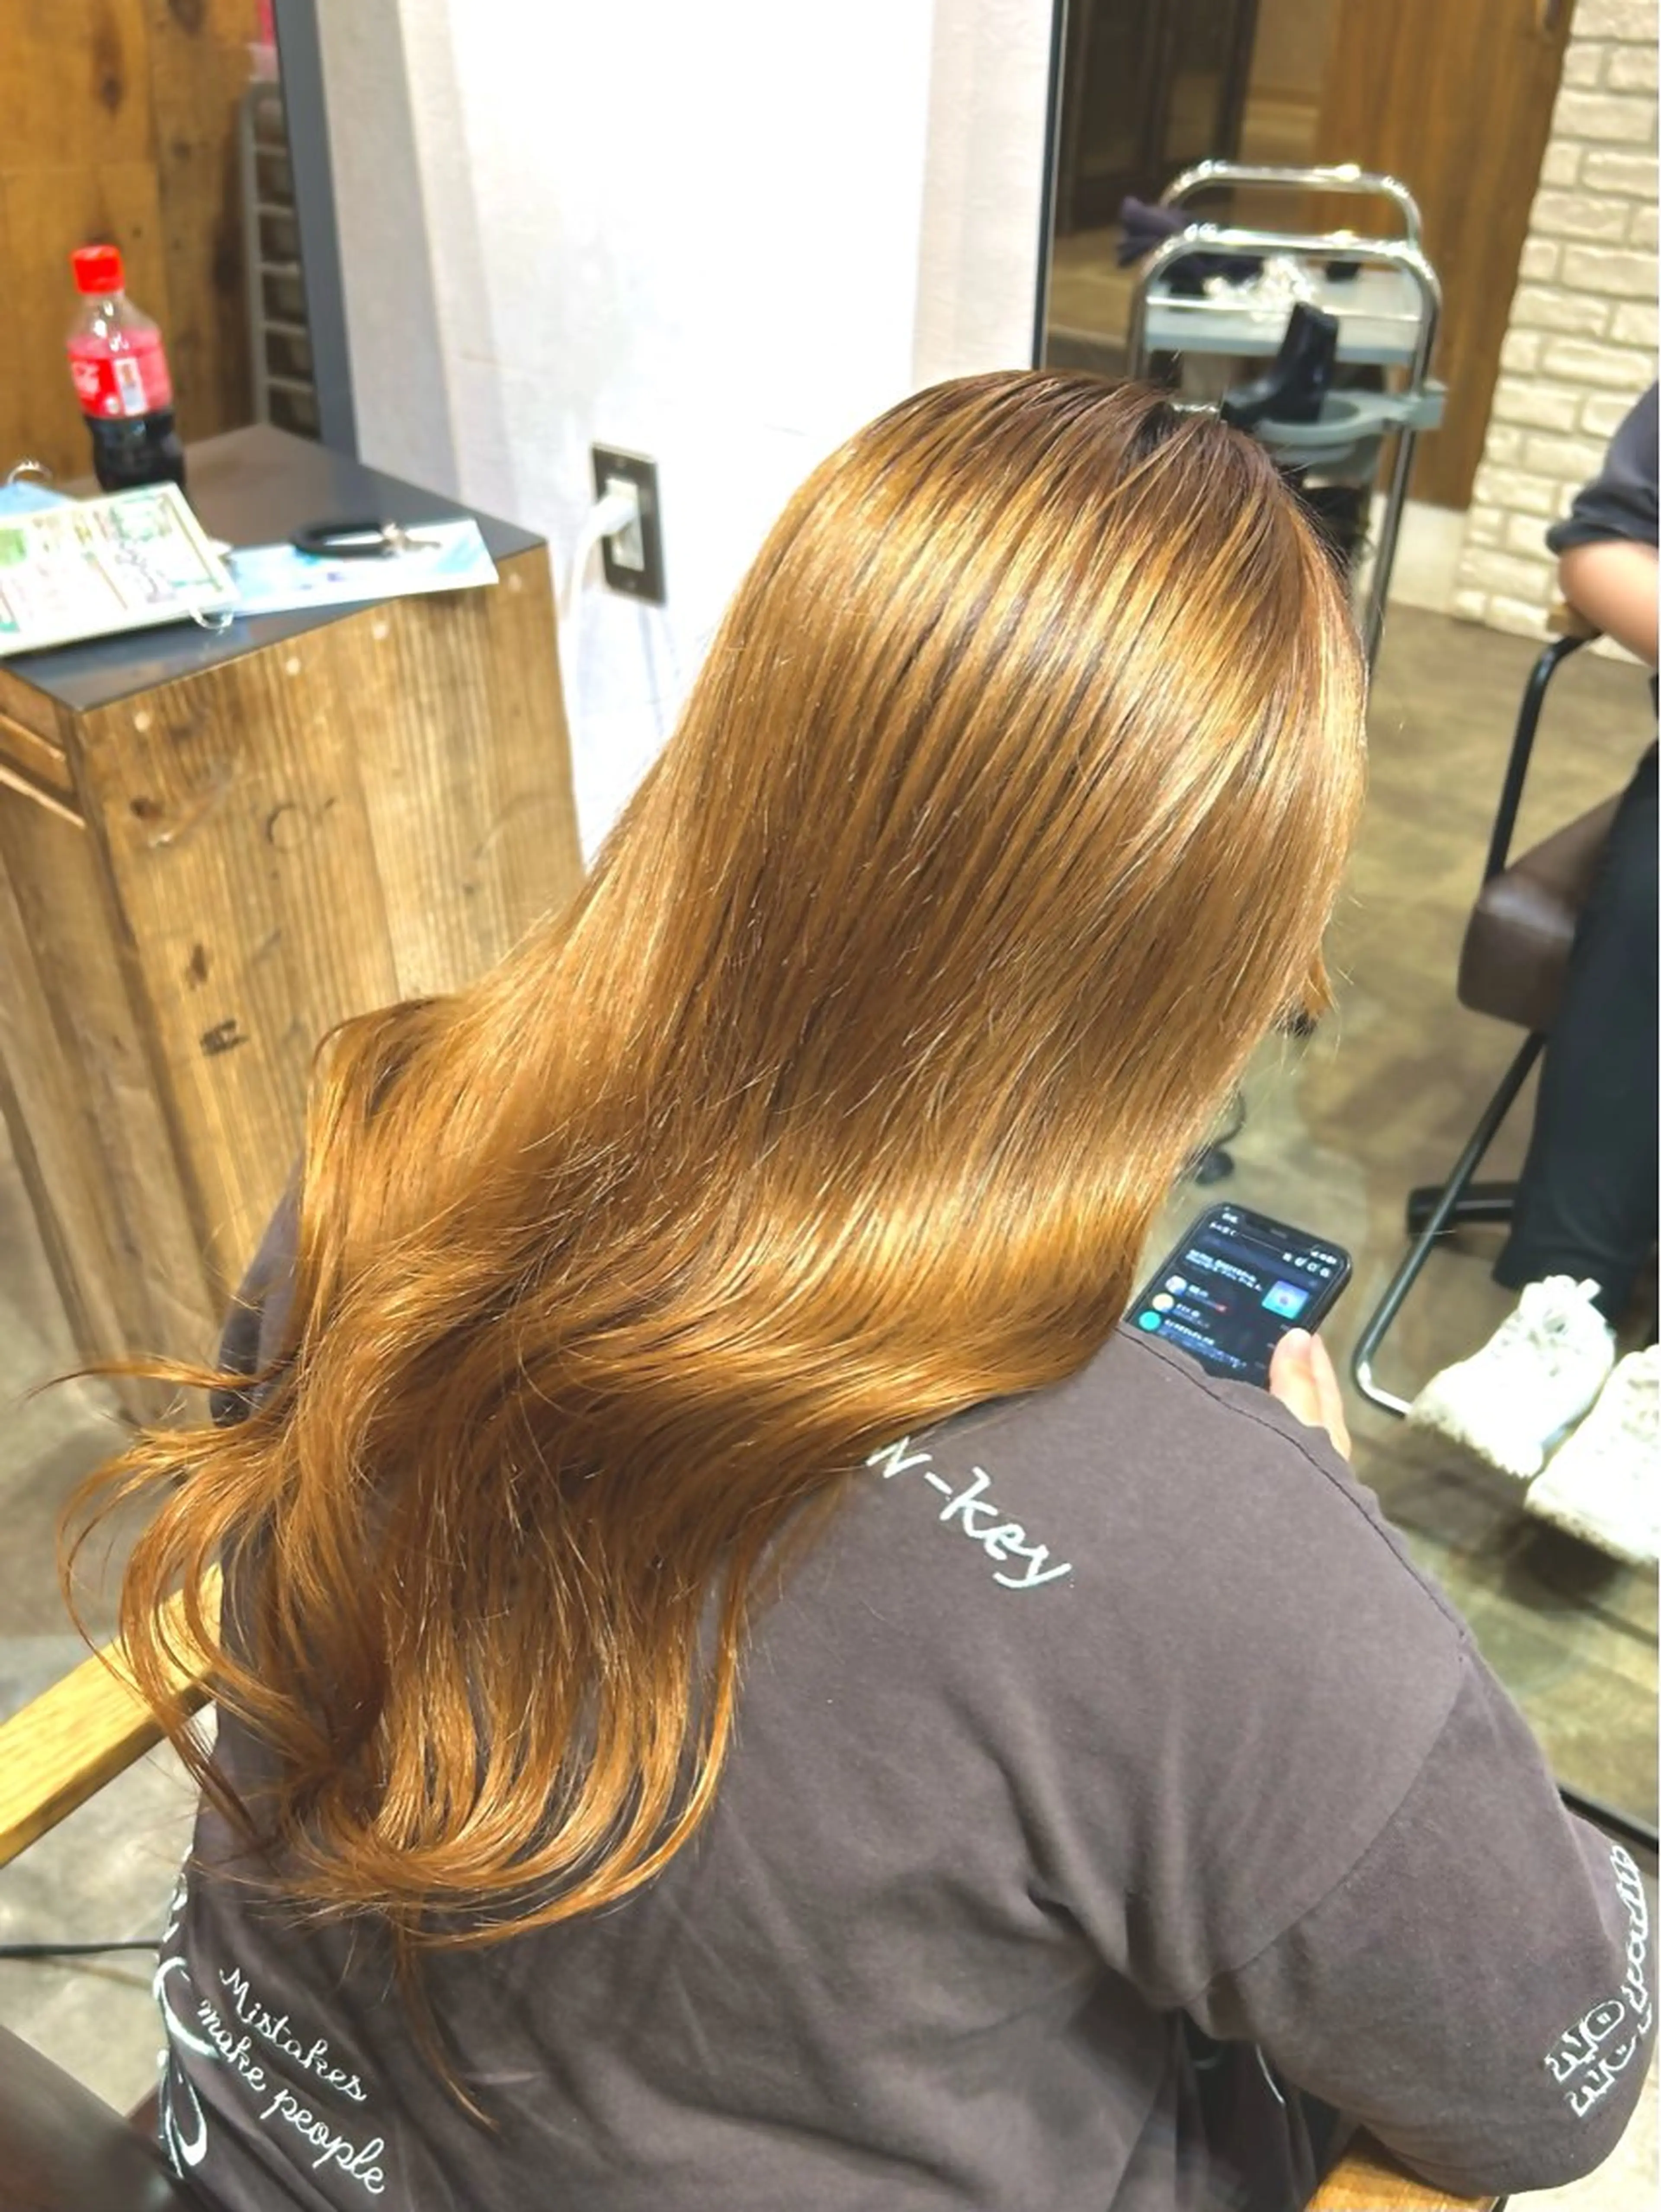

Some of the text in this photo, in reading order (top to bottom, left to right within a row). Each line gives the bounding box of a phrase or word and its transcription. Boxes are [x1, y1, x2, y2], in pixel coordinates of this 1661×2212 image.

[196, 1999, 385, 2194] make people
[219, 1968, 367, 2101] Mistakes
